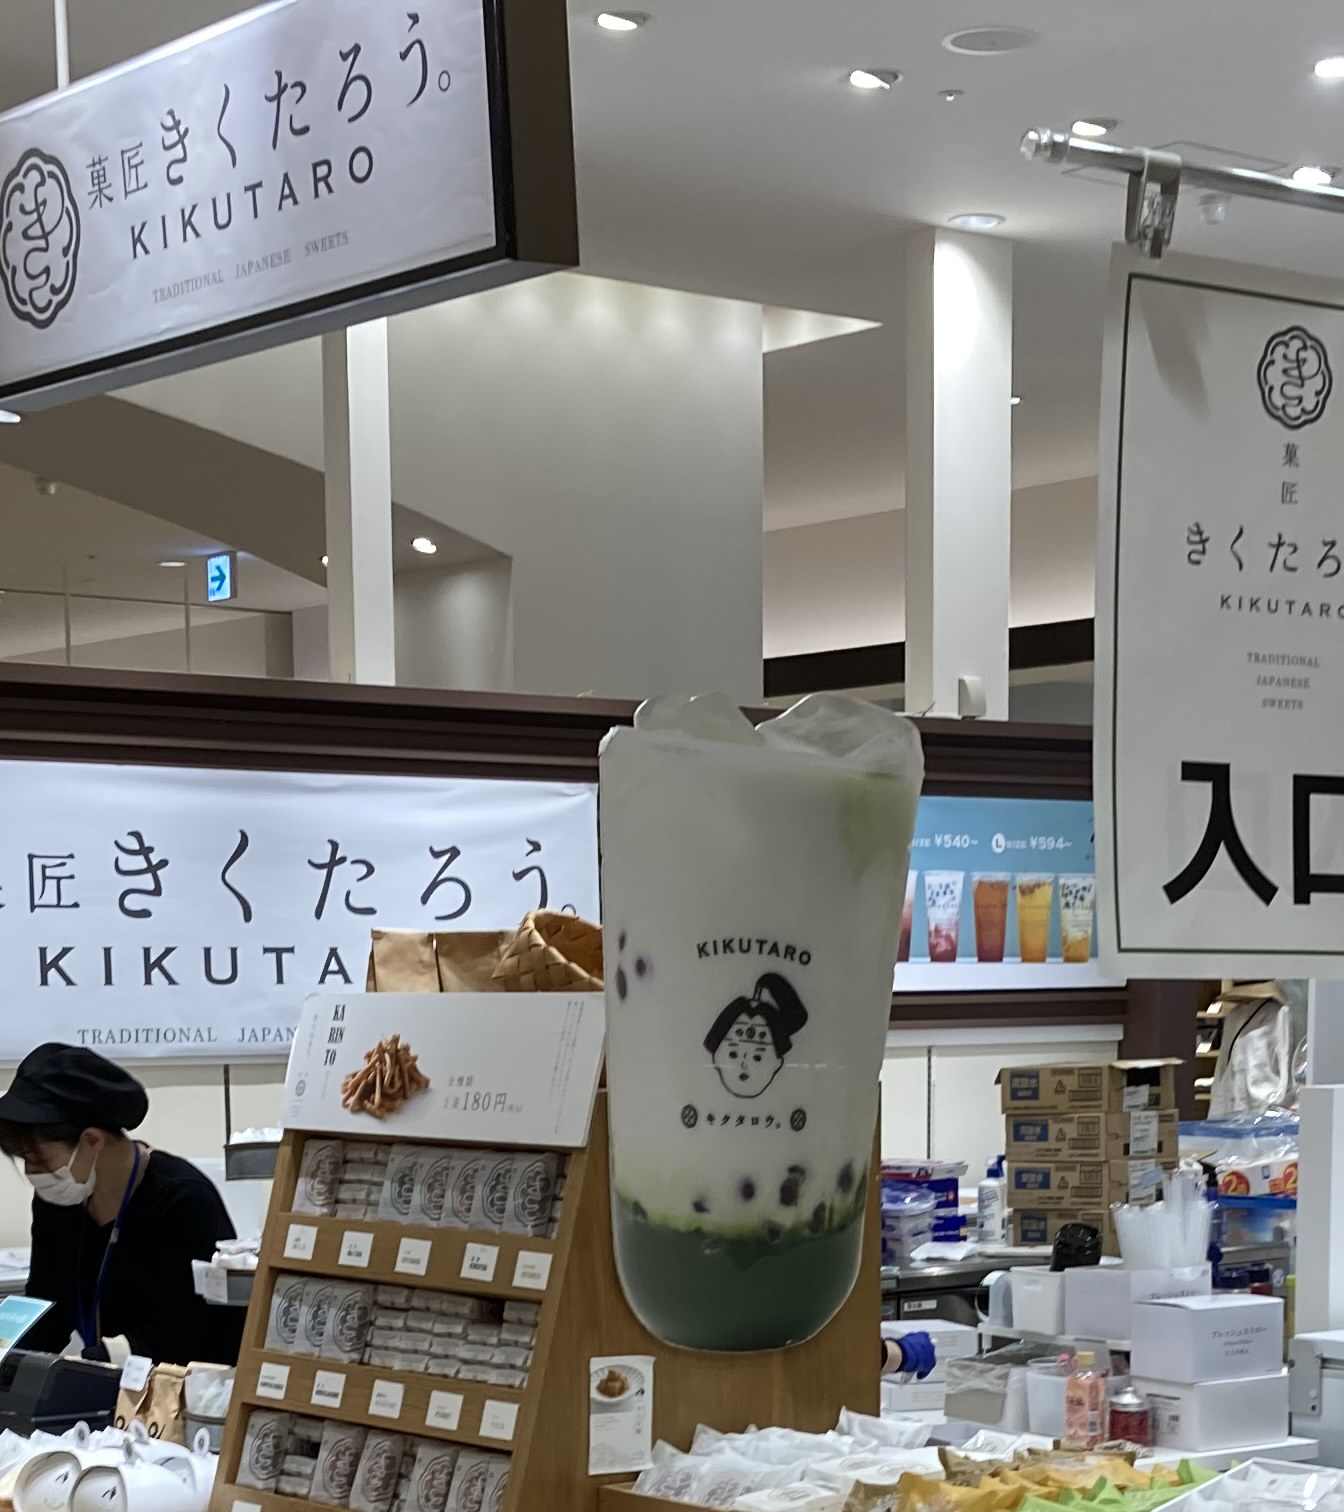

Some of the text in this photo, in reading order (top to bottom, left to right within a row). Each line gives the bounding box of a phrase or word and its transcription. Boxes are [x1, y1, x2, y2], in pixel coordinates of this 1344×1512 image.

[130, 145, 375, 260] KIKUTARO
[151, 231, 350, 303] TRADITIONAL JAPANESE SWEETS
[1246, 651, 1320, 669] TRADITIONAL
[1256, 674, 1311, 689] JAPANESE
[1261, 697, 1304, 711] SWEETS
[696, 937, 812, 966] KIKUTARO
[37, 945, 355, 988] KIKUTA
[332, 1003, 346, 1022] KA
[76, 1025, 298, 1045] TRADITIONAL JAPAN
[327, 1026, 345, 1044] RIN
[323, 1048, 337, 1067] TO
